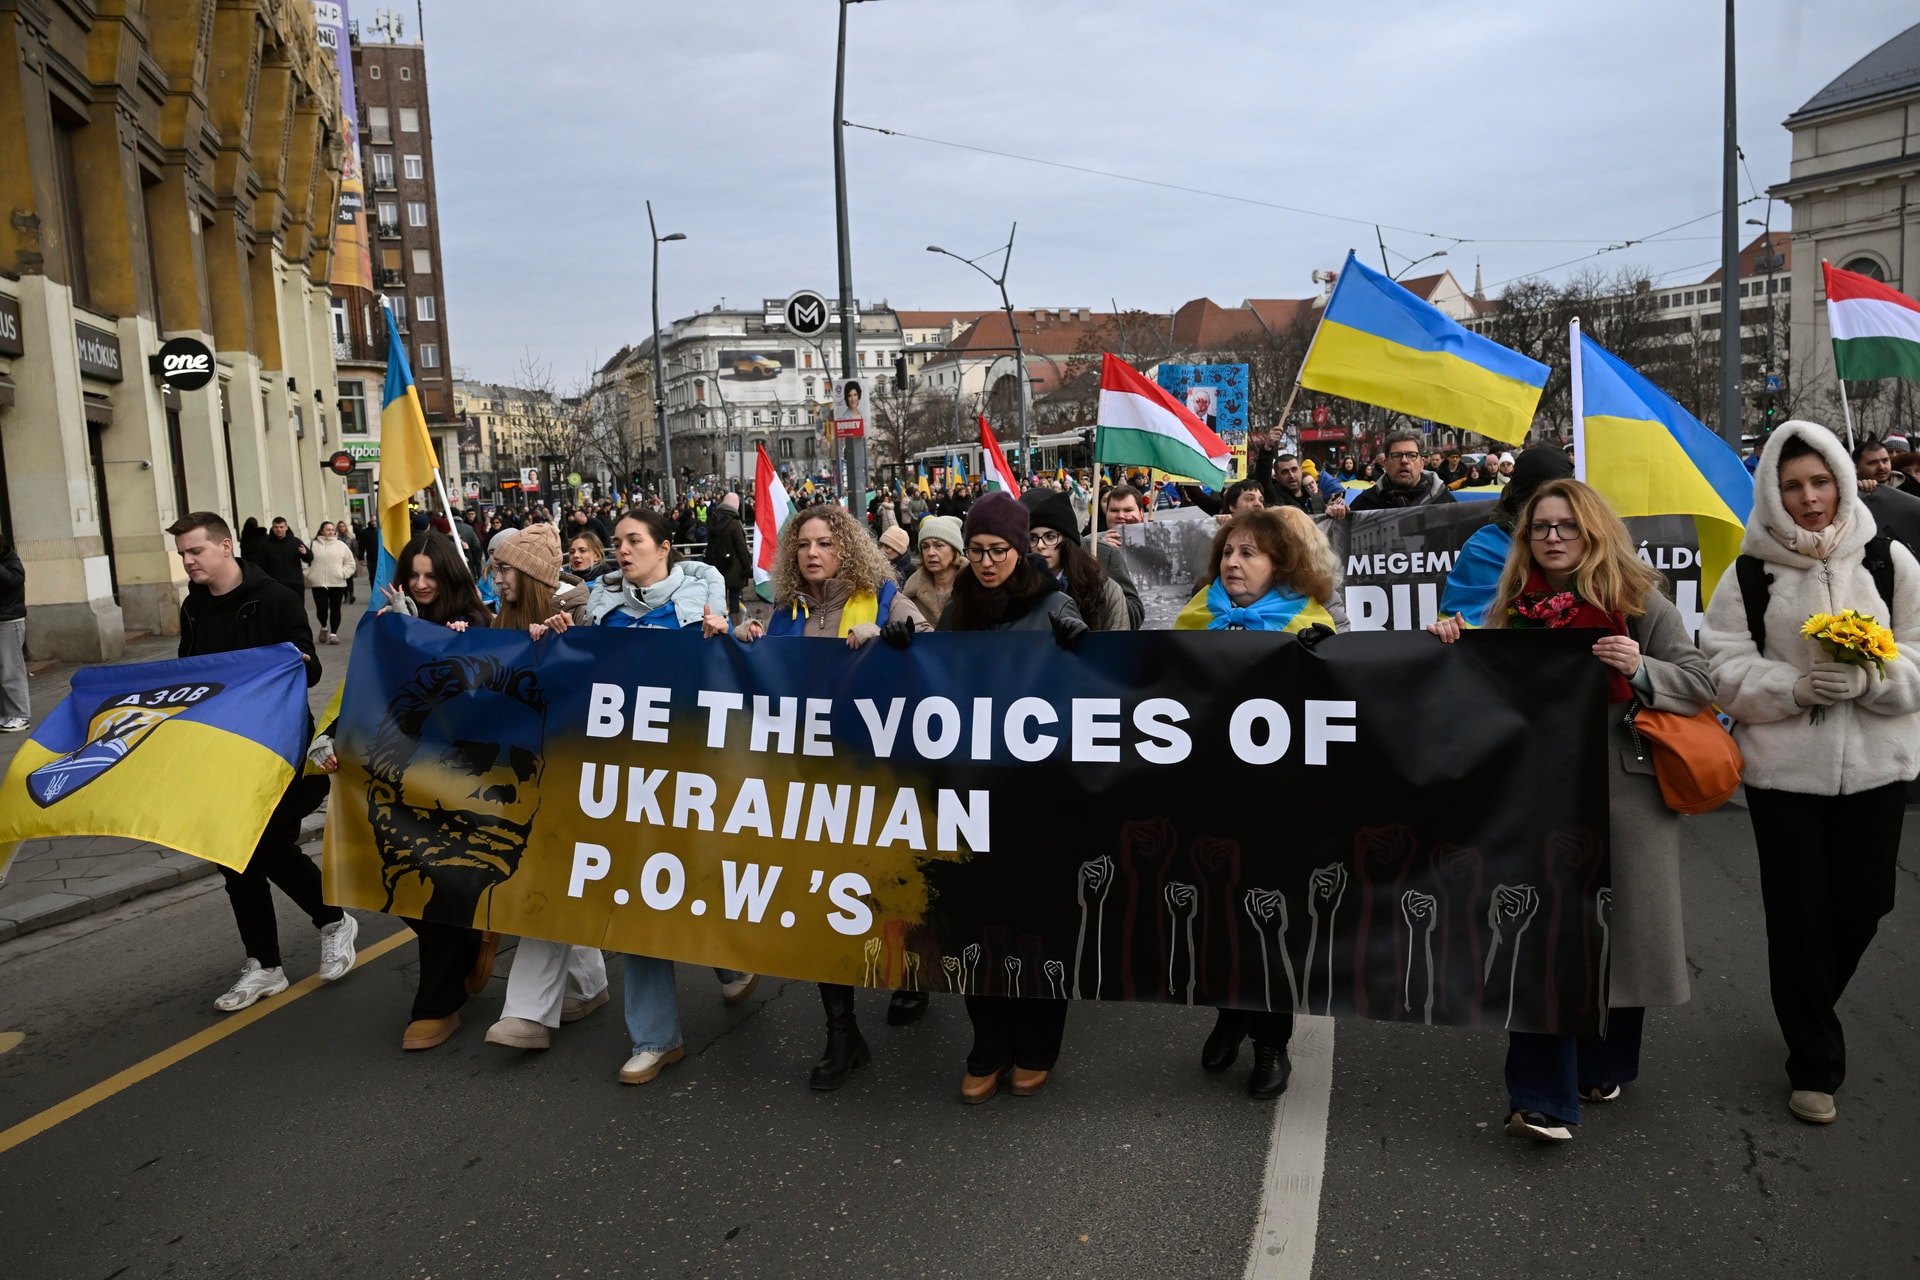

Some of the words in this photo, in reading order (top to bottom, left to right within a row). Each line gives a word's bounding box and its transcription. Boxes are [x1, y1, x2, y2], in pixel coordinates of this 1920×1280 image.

[87, 336, 118, 370] MÓKUS
[163, 353, 209, 370] one
[586, 682, 672, 744] BE
[697, 689, 834, 757] THE
[853, 695, 1193, 765] VOICES
[1229, 698, 1357, 766] OF
[578, 761, 990, 853] UKRAINIAN
